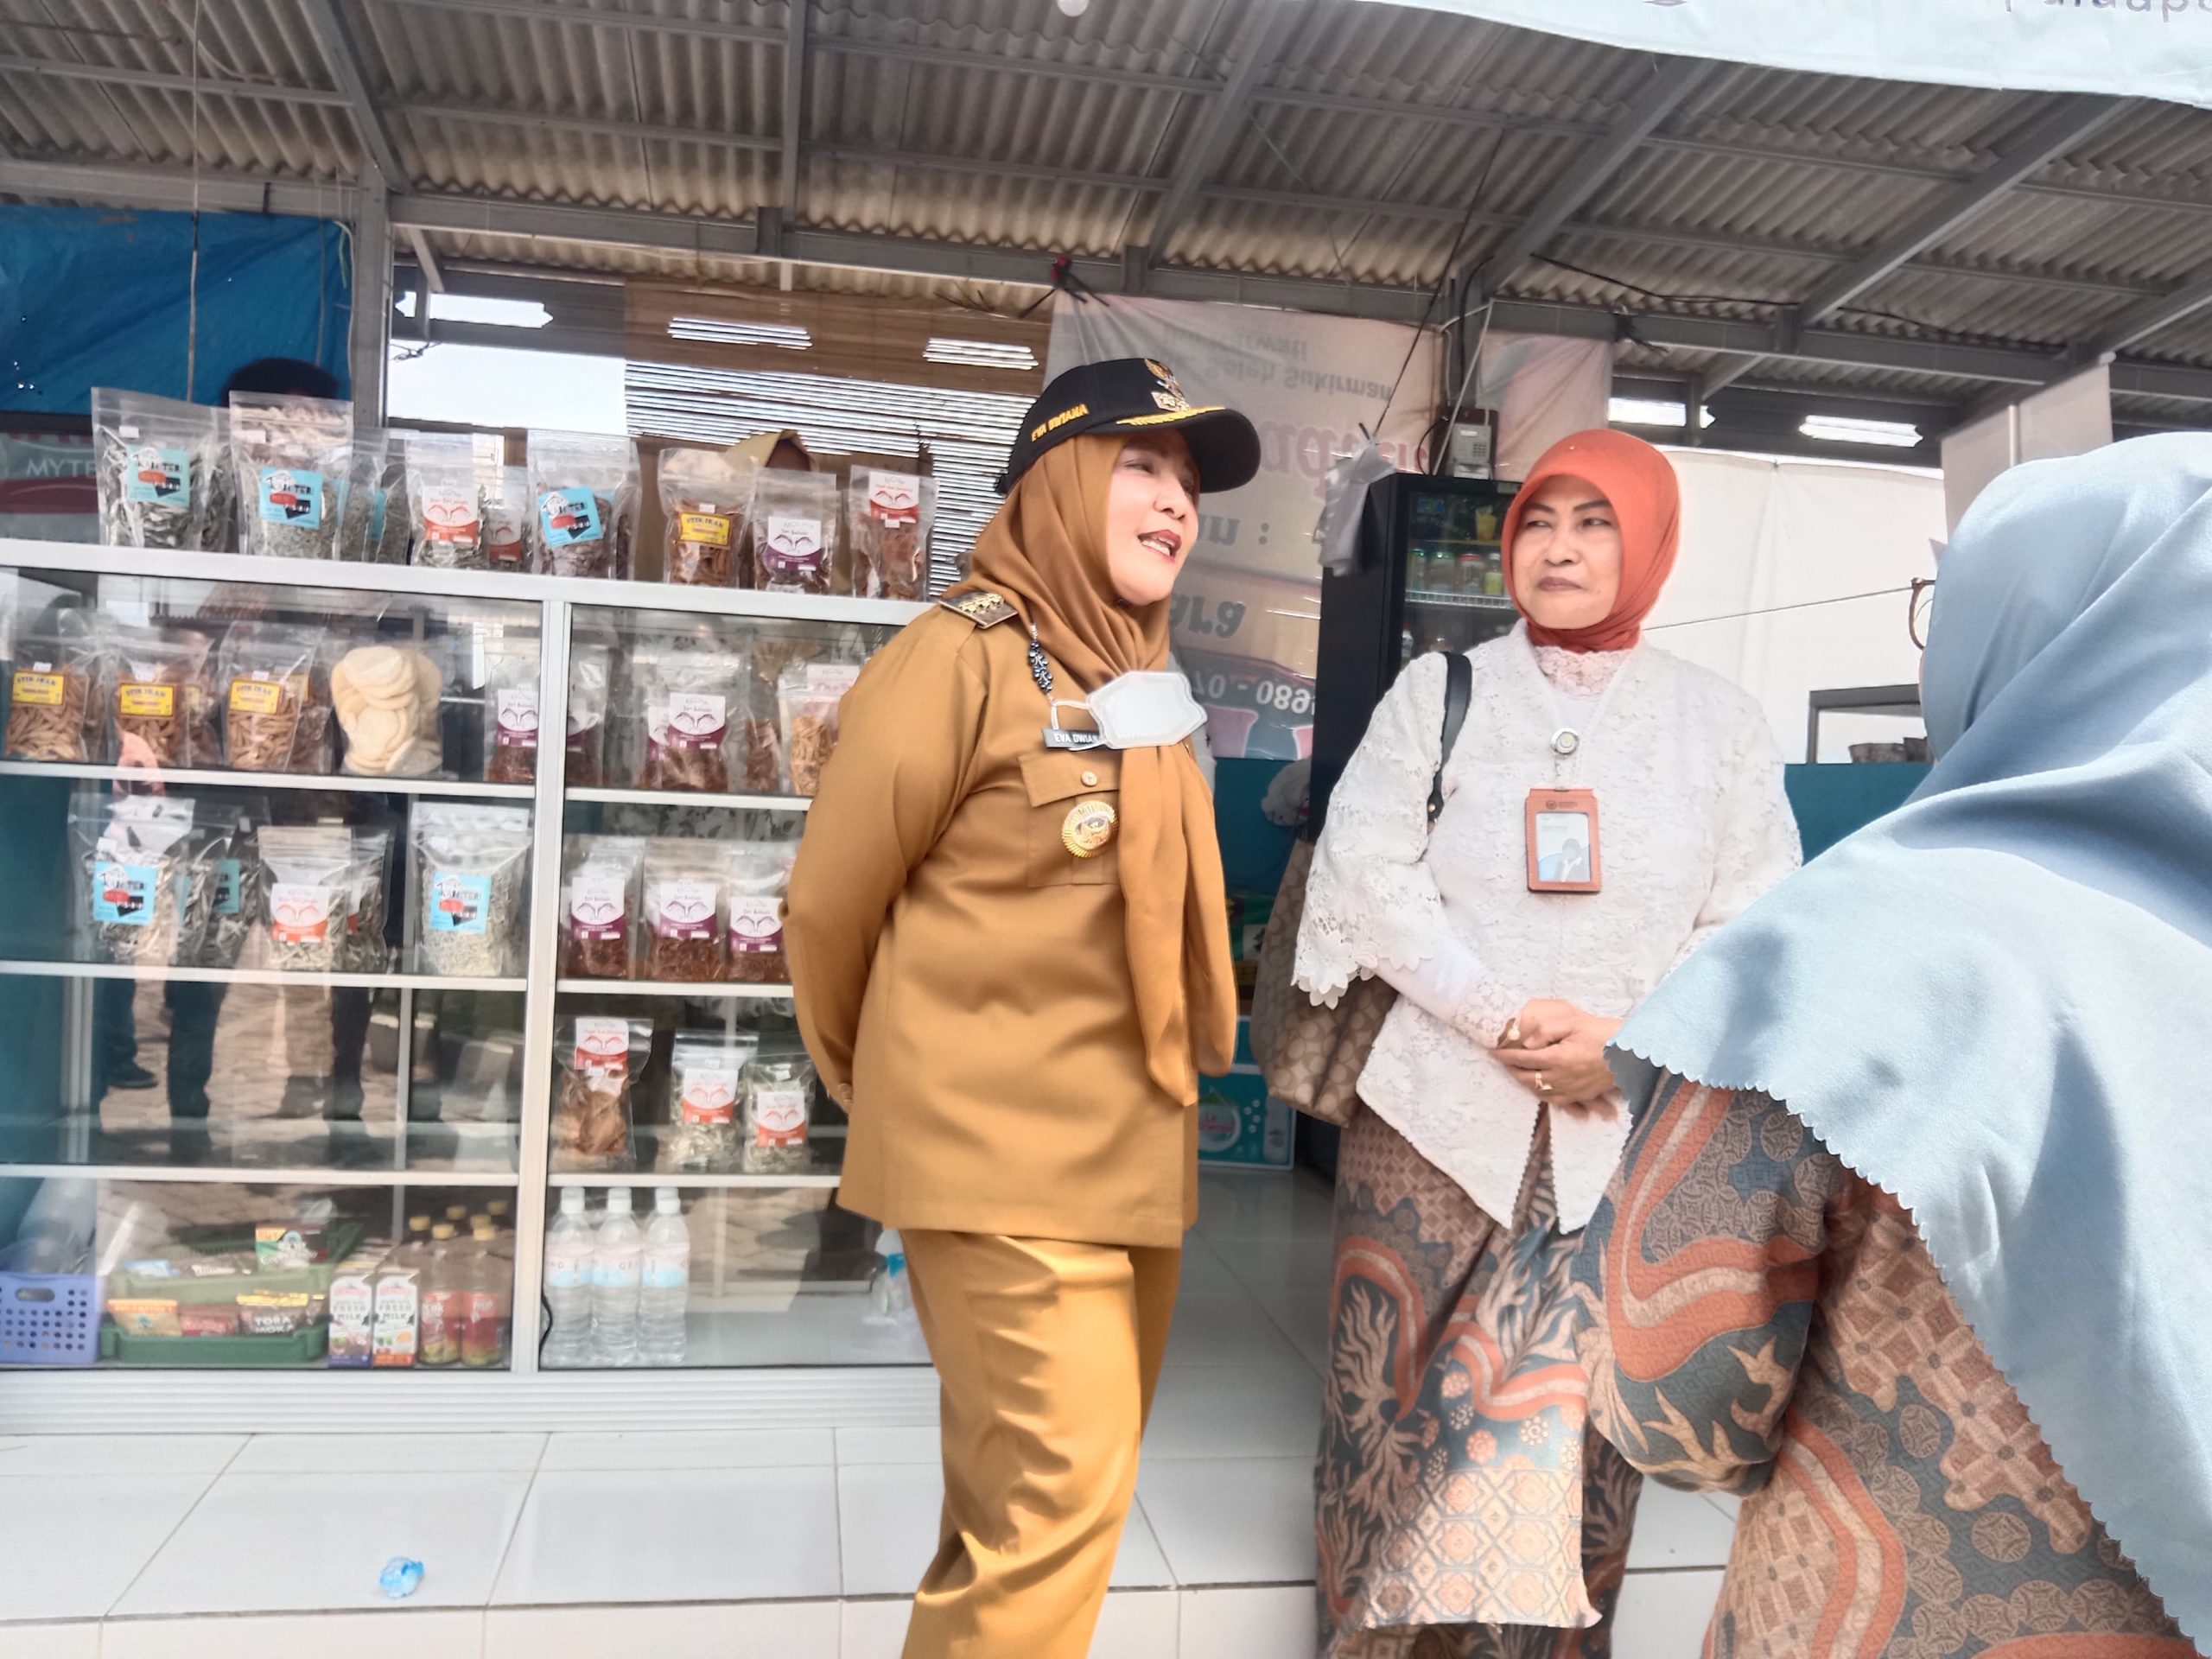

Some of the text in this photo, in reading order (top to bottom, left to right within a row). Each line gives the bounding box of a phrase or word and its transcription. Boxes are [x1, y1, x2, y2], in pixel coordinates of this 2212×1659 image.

[1053, 732, 1071, 744] EVA
[254, 1315, 293, 1325] TORA
[383, 1313, 409, 1321] MILK
